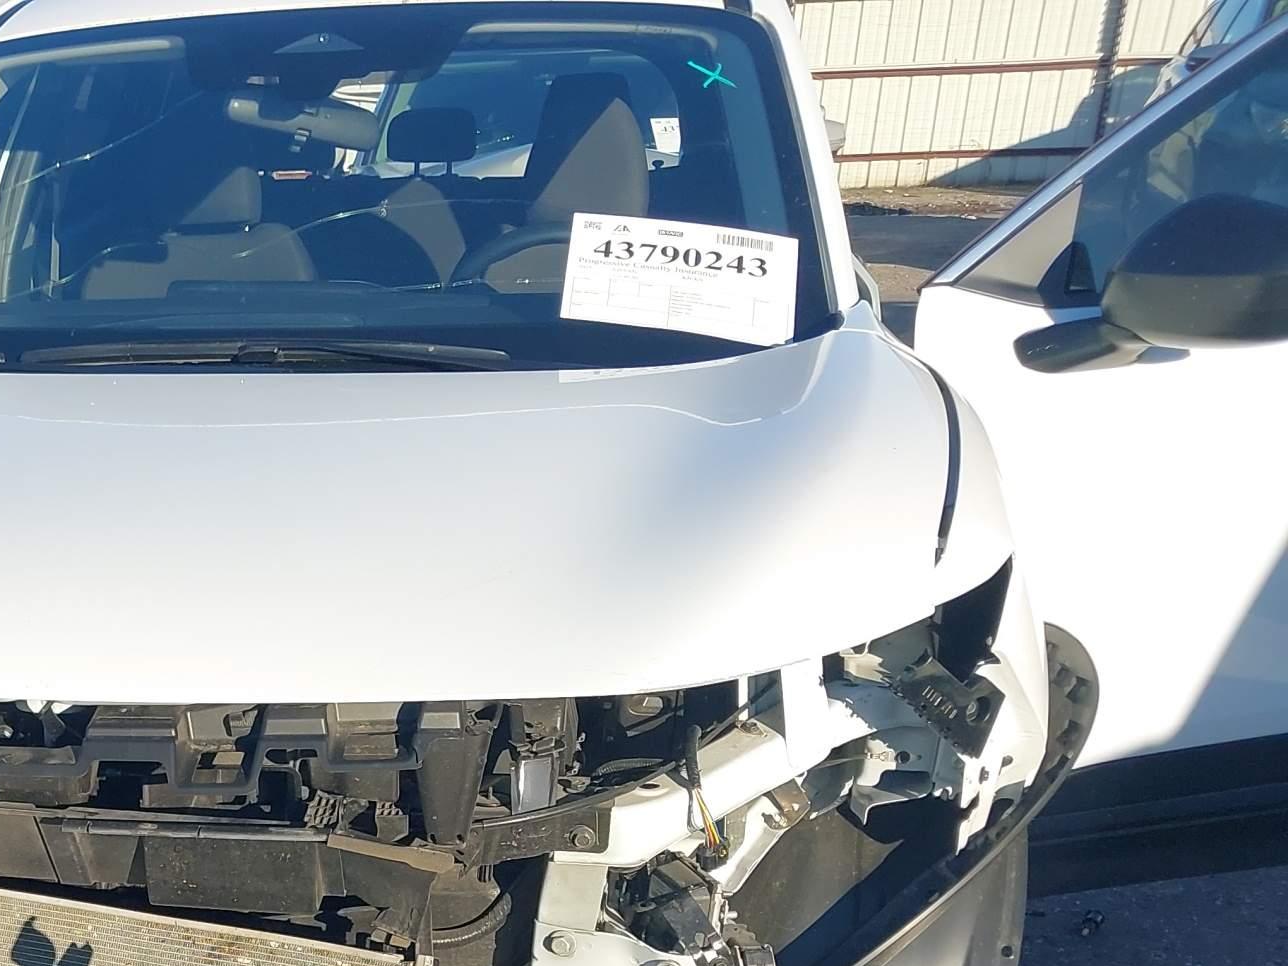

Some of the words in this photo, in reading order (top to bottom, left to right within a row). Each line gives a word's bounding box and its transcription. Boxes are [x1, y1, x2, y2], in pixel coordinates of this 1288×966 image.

[579, 257, 631, 268] Progressive
[675, 266, 718, 278] Insurance
[593, 240, 768, 278] 43790243
